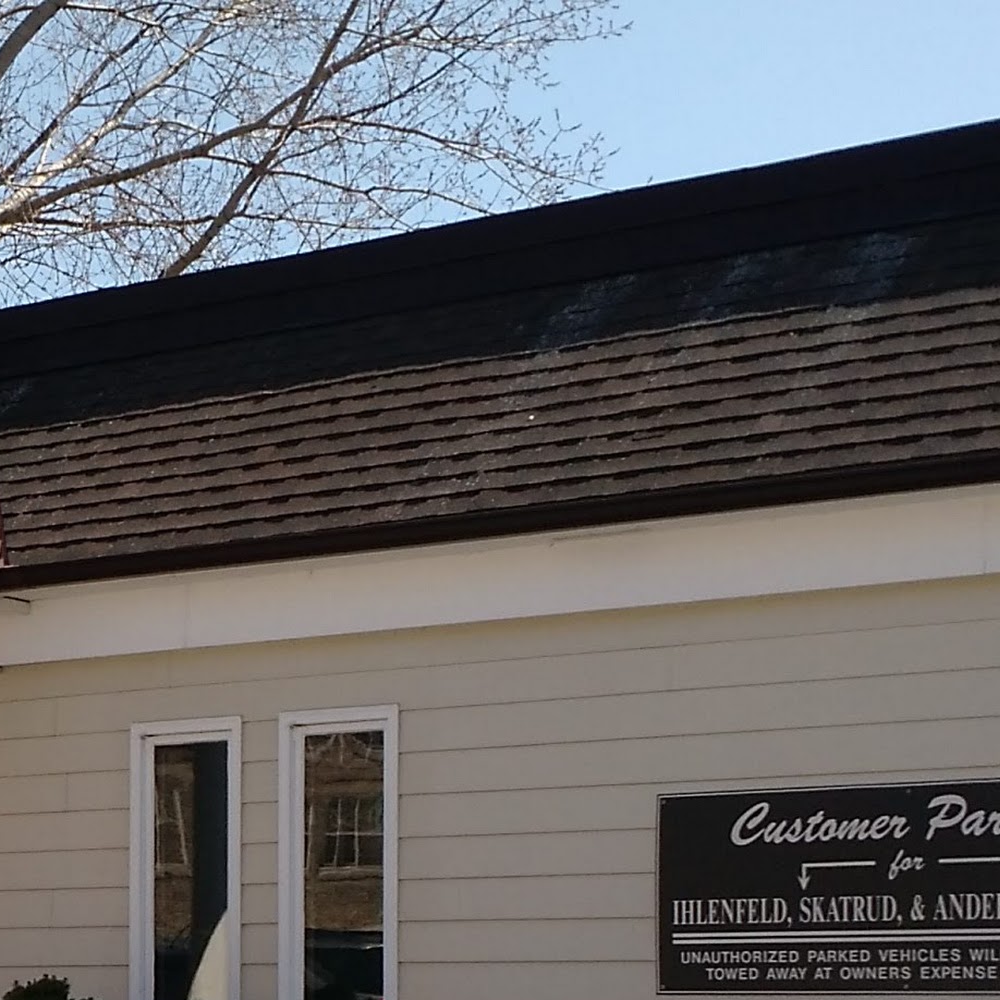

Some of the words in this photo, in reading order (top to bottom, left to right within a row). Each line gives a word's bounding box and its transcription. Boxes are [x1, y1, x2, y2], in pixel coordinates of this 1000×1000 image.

[730, 802, 911, 846] Customer
[888, 850, 925, 880] for
[672, 898, 792, 927] IHLENFELD,
[800, 895, 902, 927] SKATRUD,
[910, 894, 925, 921] &
[933, 892, 1000, 921] ANDE
[680, 950, 800, 964] UNAUTHORIZED
[807, 949, 871, 963] PARKED
[878, 948, 961, 963] VEHICLES
[968, 948, 1000, 962] WIL
[706, 966, 759, 981] TOWED
[766, 967, 807, 980] AWAY
[814, 966, 832, 980] AT
[839, 966, 911, 980] OWNERS
[920, 965, 998, 980] EXPENSE
